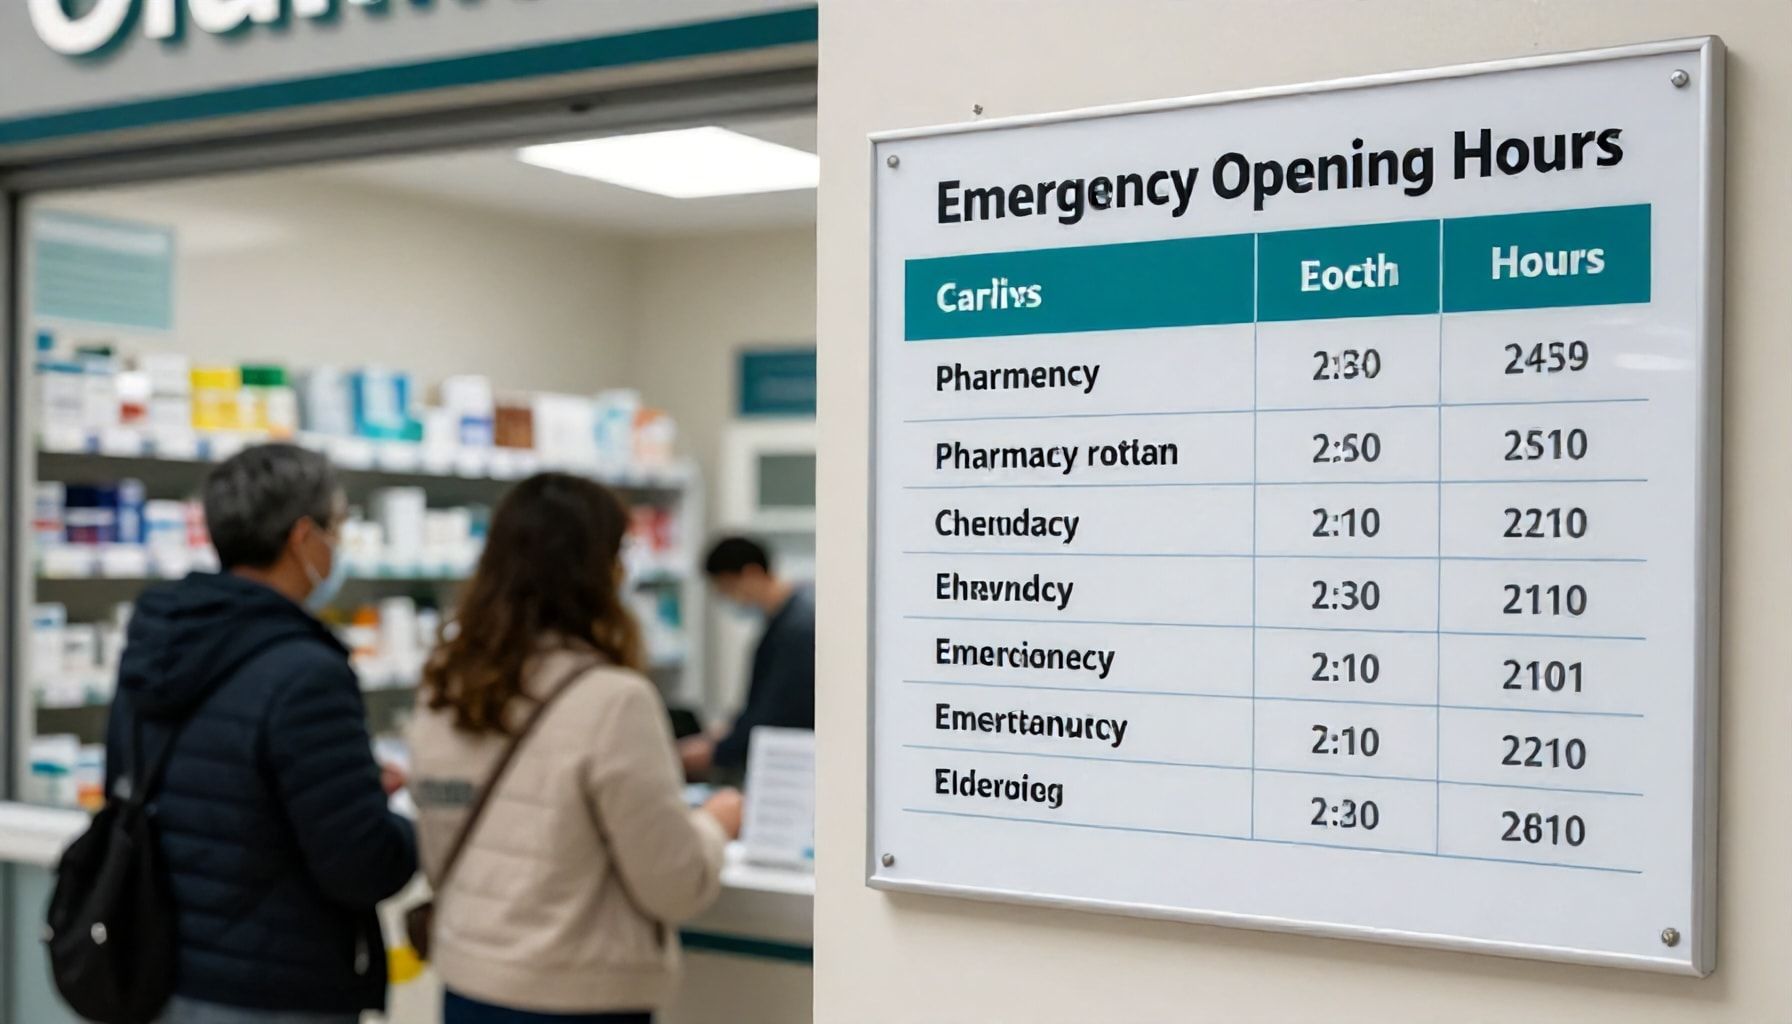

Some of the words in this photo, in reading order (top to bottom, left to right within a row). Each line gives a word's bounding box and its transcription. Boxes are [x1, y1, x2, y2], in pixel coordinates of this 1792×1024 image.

[936, 165, 1199, 226] Emergency
[1211, 137, 1435, 212] Opening
[1452, 126, 1624, 181] Hours
[1491, 246, 1606, 280] Hours
[935, 362, 1101, 395] Pharmency
[1503, 340, 1589, 375] 2459
[935, 441, 1079, 476] Pharmacy
[1503, 428, 1588, 461] 2510
[1311, 507, 1381, 538] 2:10
[1503, 507, 1588, 539] 2210
[1311, 580, 1381, 611] 2:30
[1502, 583, 1588, 617] 2110
[1311, 651, 1381, 684] 2:10
[1502, 659, 1583, 693] 2101
[1310, 724, 1381, 757] 2:10
[1501, 734, 1587, 770] 2210
